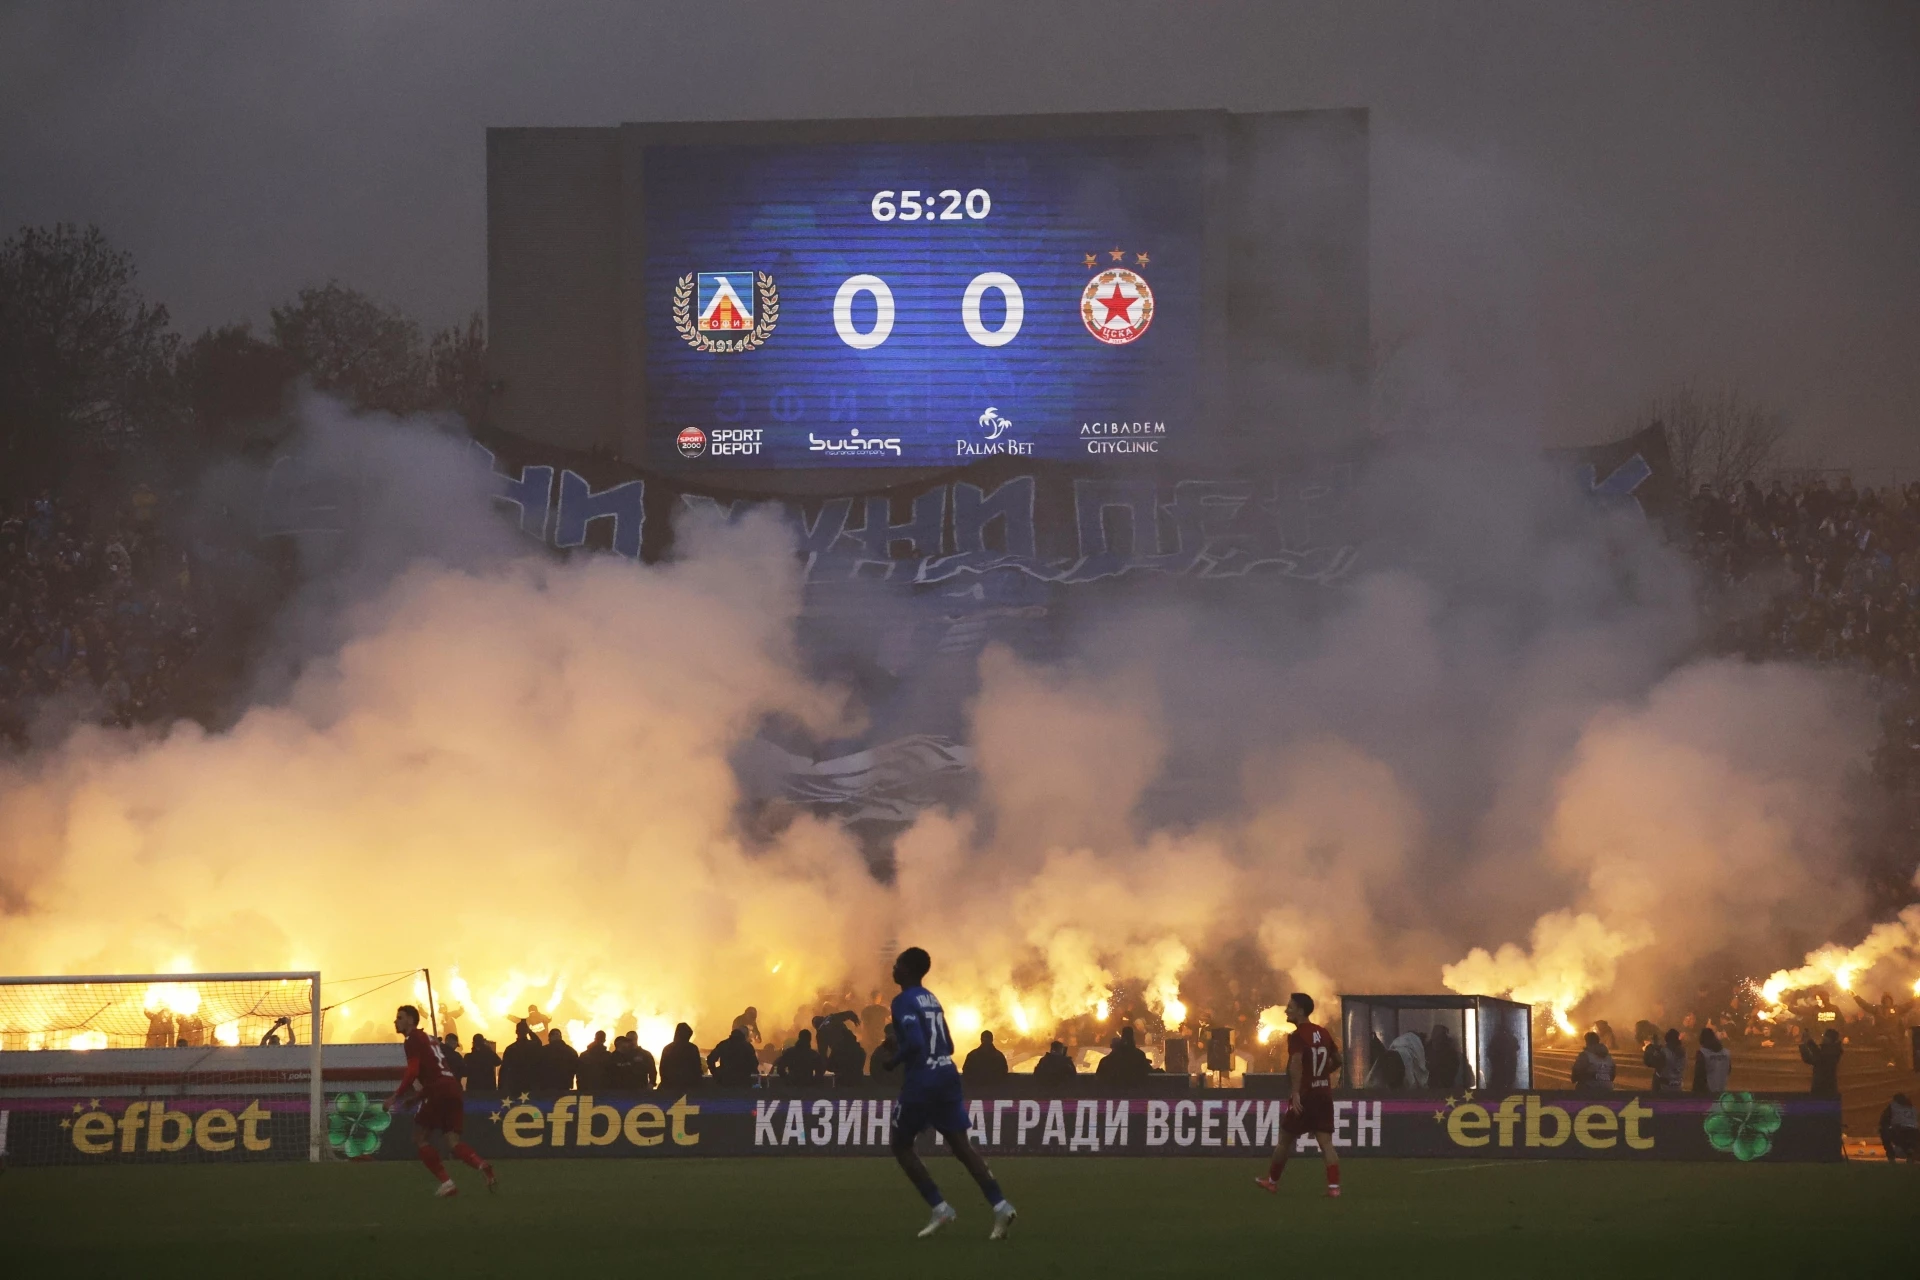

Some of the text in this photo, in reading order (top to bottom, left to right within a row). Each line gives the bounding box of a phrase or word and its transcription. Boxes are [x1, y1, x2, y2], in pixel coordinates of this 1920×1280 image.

[871, 188, 991, 221] 65:20
[833, 272, 1024, 349] 0 0
[708, 340, 744, 353] 1914
[1102, 327, 1134, 339] ЦСКА
[711, 429, 763, 442] SPORT
[711, 442, 763, 455] DEPOT
[1008, 439, 1035, 455] BET
[1311, 1046, 1328, 1077] 17
[72, 1100, 271, 1153] efbet
[502, 1094, 700, 1147] efbet
[754, 1099, 900, 1146] КАЗИН
[914, 1100, 1129, 1152] АГРАДИ
[1146, 1100, 1280, 1147] ВСЕКИ
[1447, 1095, 1655, 1149] efbet
